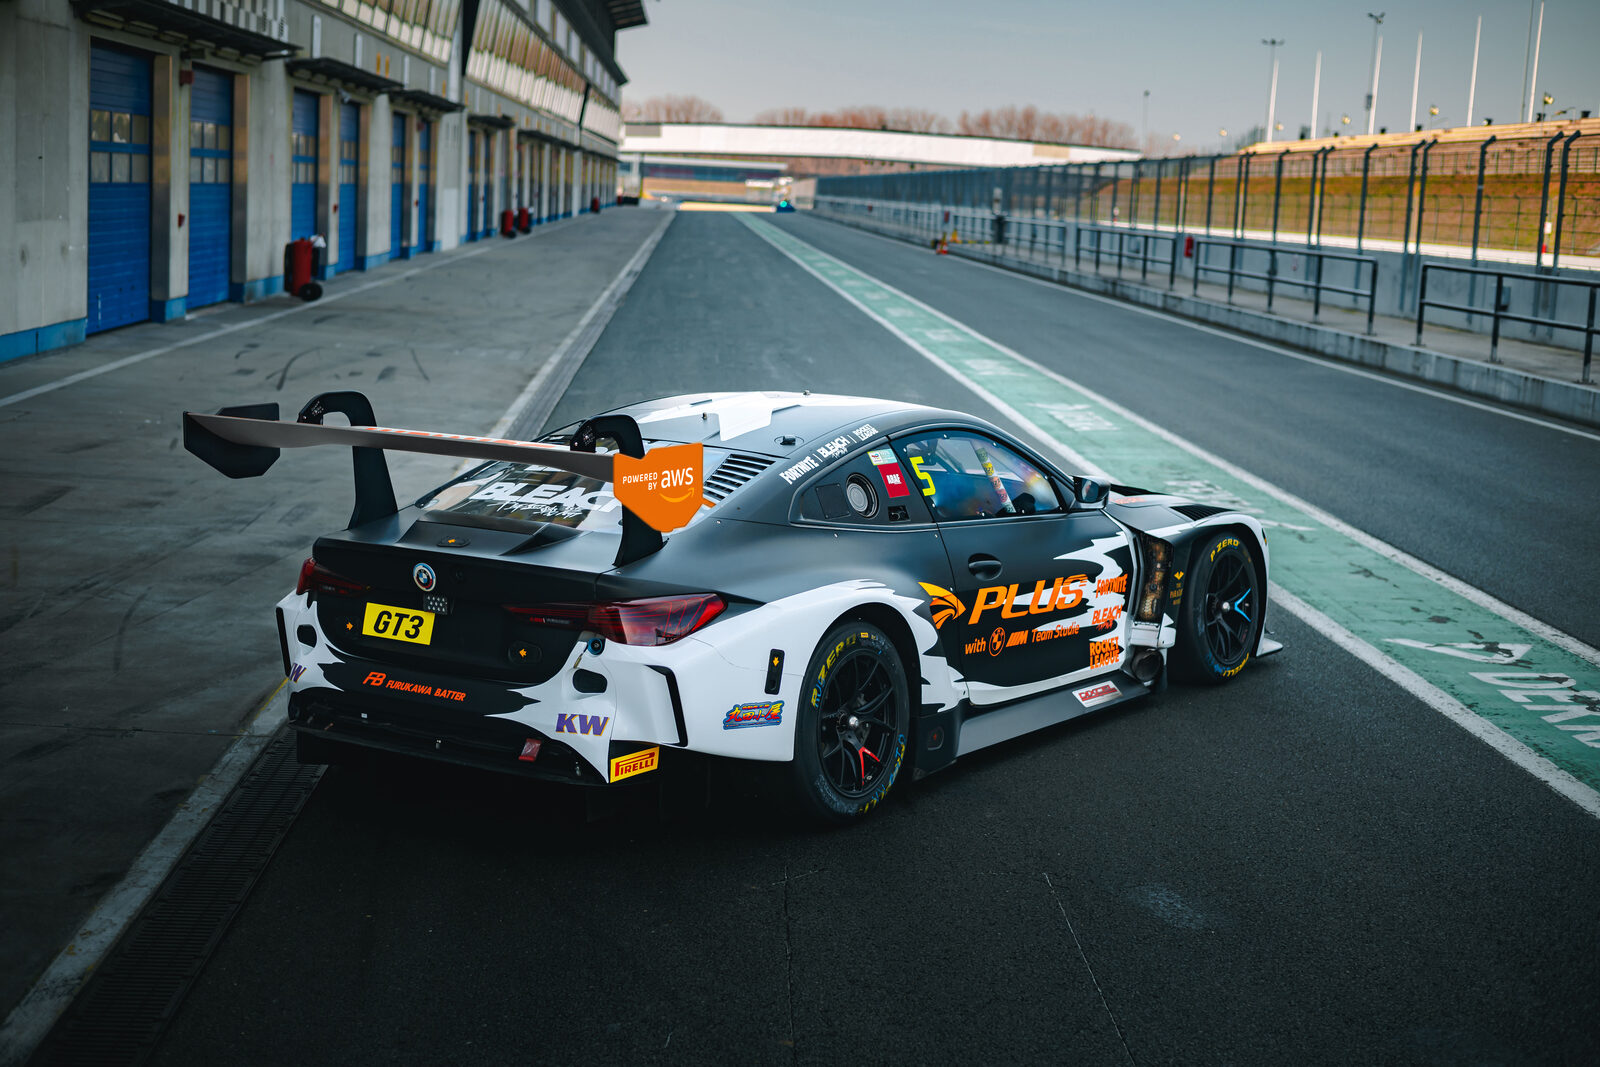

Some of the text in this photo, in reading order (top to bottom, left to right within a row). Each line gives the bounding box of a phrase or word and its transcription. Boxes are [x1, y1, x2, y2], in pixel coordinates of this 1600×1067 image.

[778, 456, 820, 485] FORTNITE
[816, 436, 851, 457] BLEACH
[622, 472, 658, 485] POWERED
[647, 482, 658, 491] BY
[661, 467, 694, 489] aws
[909, 456, 936, 496] 5
[469, 482, 622, 513] BLEAC
[1217, 538, 1239, 552] ZERO
[1095, 573, 1128, 599] FORTNITE
[967, 574, 1088, 626] PLUS
[373, 610, 424, 639] GT3
[1091, 605, 1123, 626] BLEACH
[965, 637, 986, 655] with
[1031, 629, 1053, 644] Team
[1054, 621, 1080, 639] Studie
[1089, 636, 1119, 657] ROCKET
[1089, 649, 1120, 670] LEAGUE
[385, 680, 432, 695] FURUKAWA
[434, 688, 467, 701] BATTER
[555, 713, 610, 736] KW
[614, 752, 656, 777] PIRELLI
